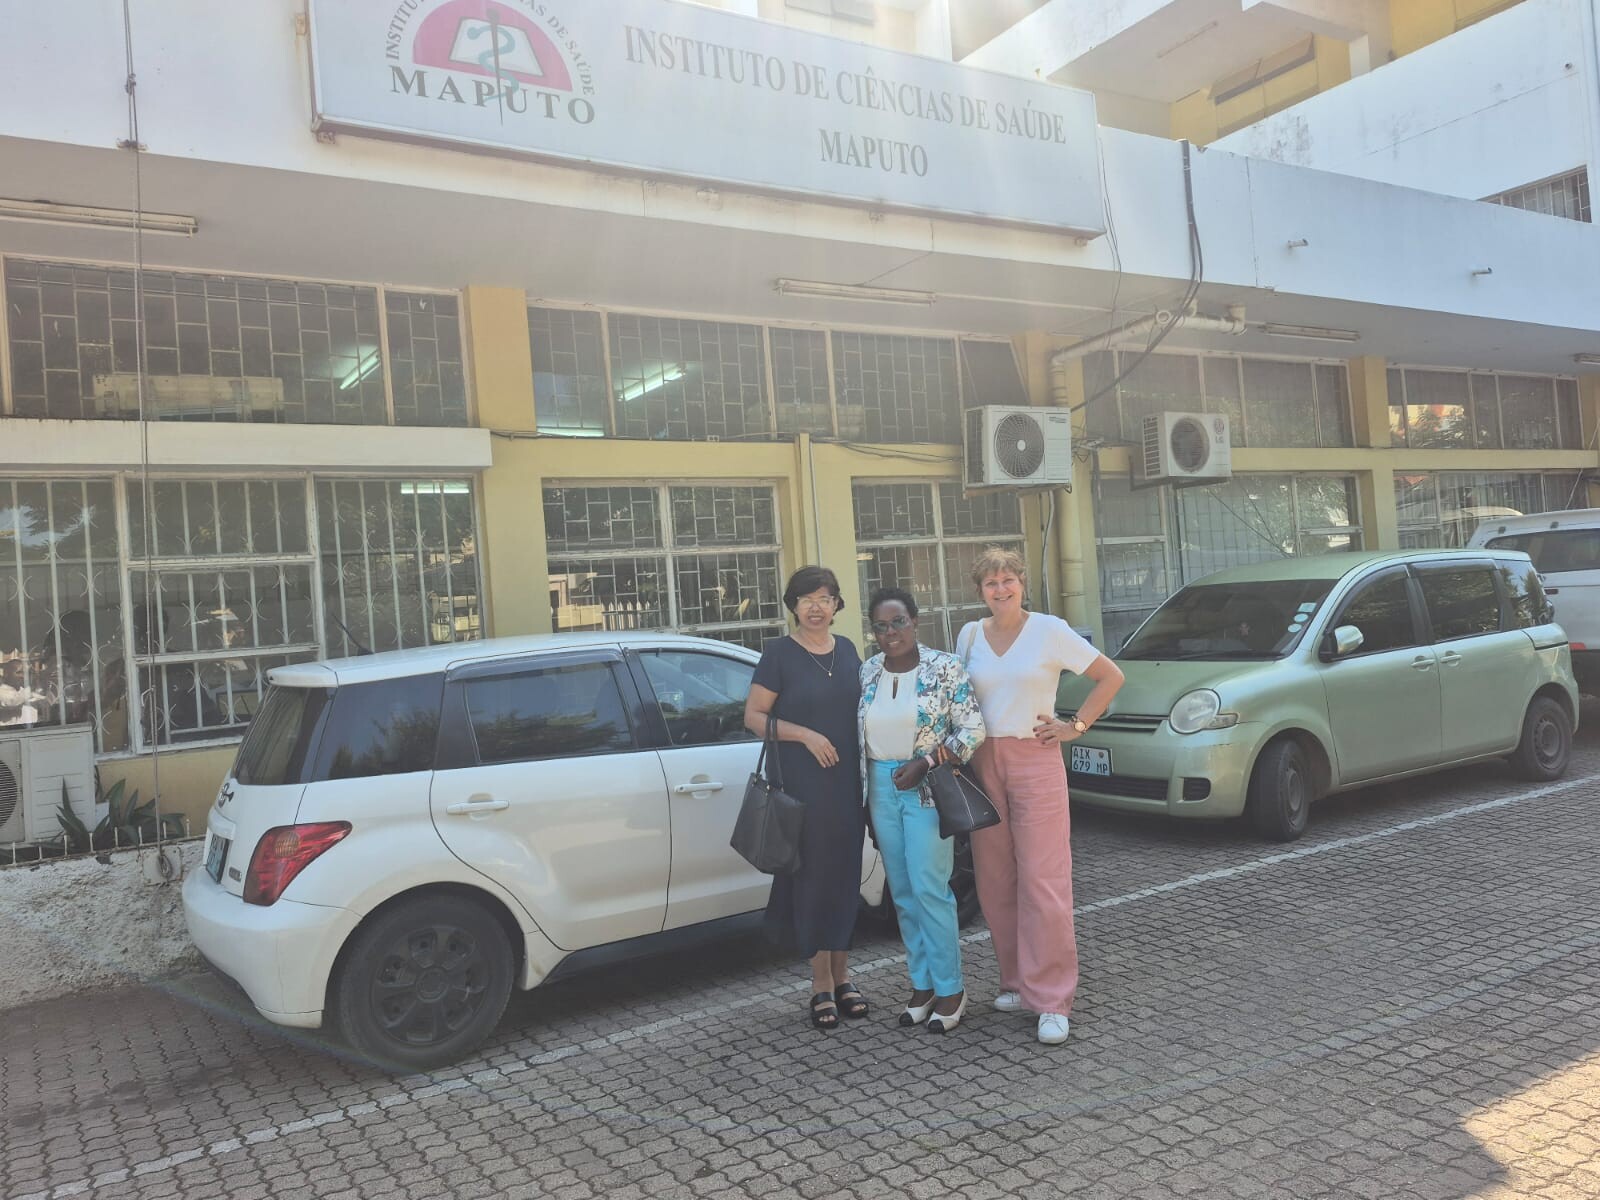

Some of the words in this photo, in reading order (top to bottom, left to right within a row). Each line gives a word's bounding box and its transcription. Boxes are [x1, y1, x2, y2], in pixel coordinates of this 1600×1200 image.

[385, 0, 424, 60] INSTITU
[546, 16, 568, 39] DE
[389, 64, 595, 125] MAPUTO
[624, 25, 786, 92] INSTITUTO
[792, 61, 830, 100] DE
[836, 66, 953, 124] CIÊNCIAS
[960, 96, 990, 130] DE
[995, 99, 1066, 145] SAÚDE
[819, 128, 928, 177] MAPUTO
[1073, 747, 1090, 760] AIX
[1073, 759, 1091, 772] 679
